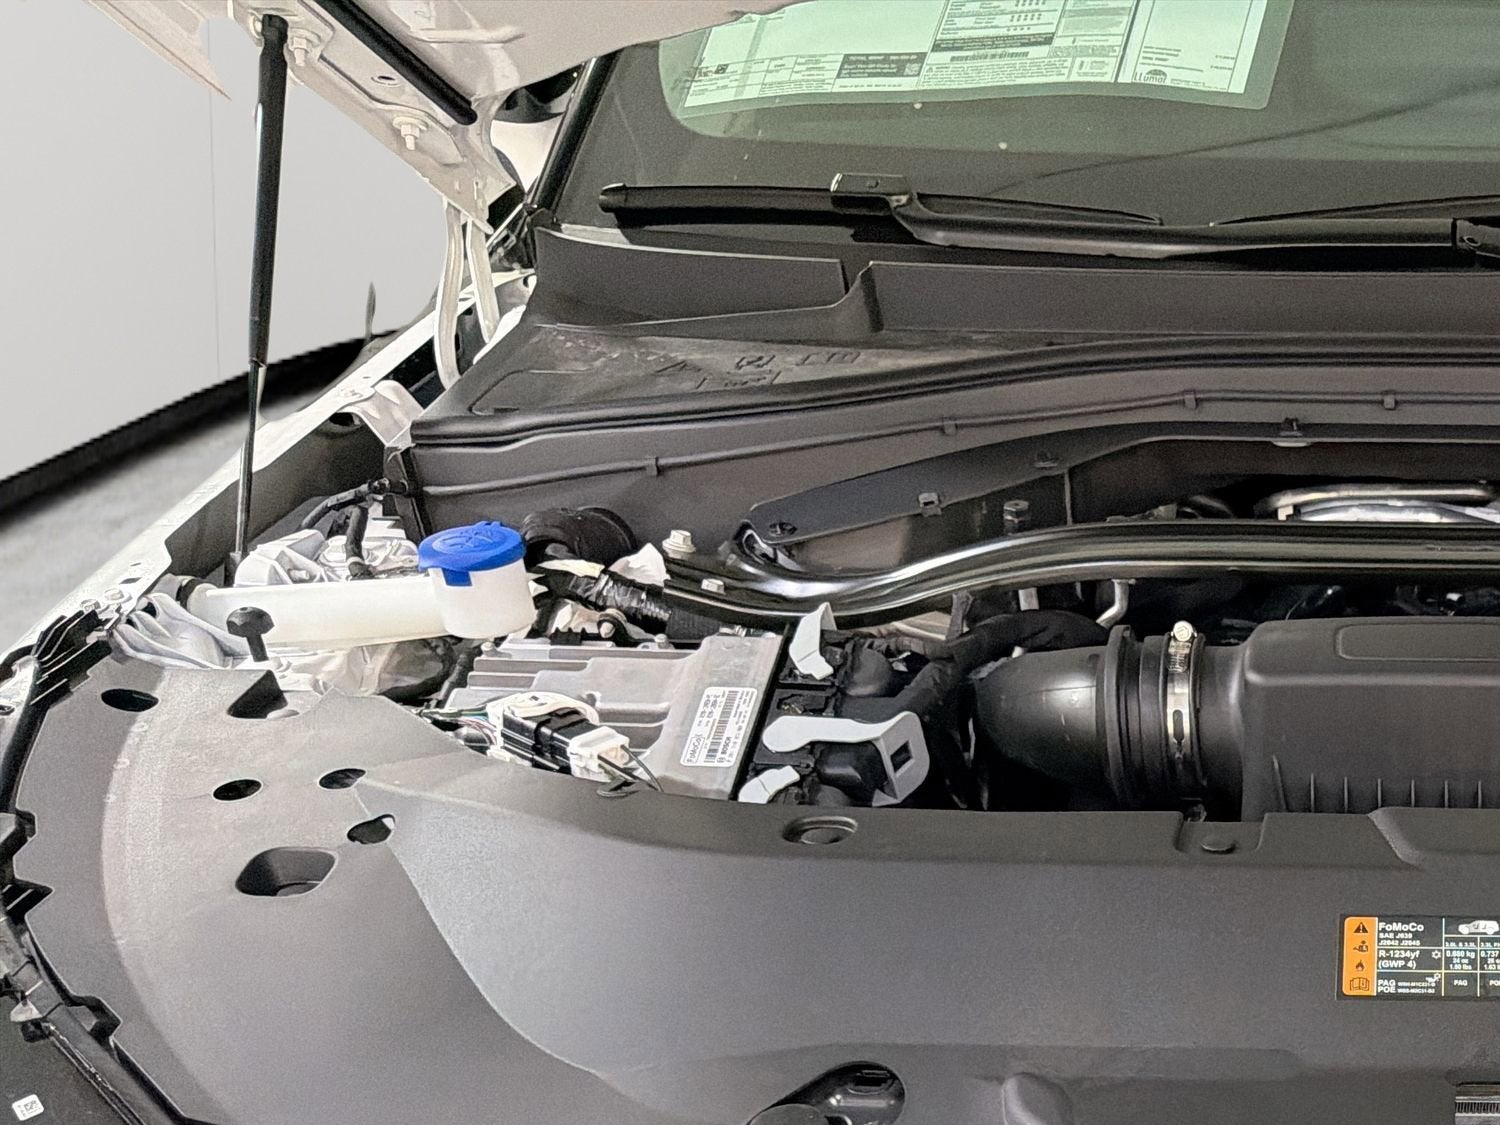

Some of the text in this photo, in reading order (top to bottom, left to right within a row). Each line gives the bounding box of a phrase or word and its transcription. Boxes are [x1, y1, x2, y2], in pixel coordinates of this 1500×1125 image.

[1378, 922, 1425, 932] FoMoCo
[1378, 949, 1420, 960] R-1234yf
[1466, 950, 1476, 959] kg
[1480, 950, 1499, 958] 0.737
[1378, 959, 1417, 970] (GWP 4)
